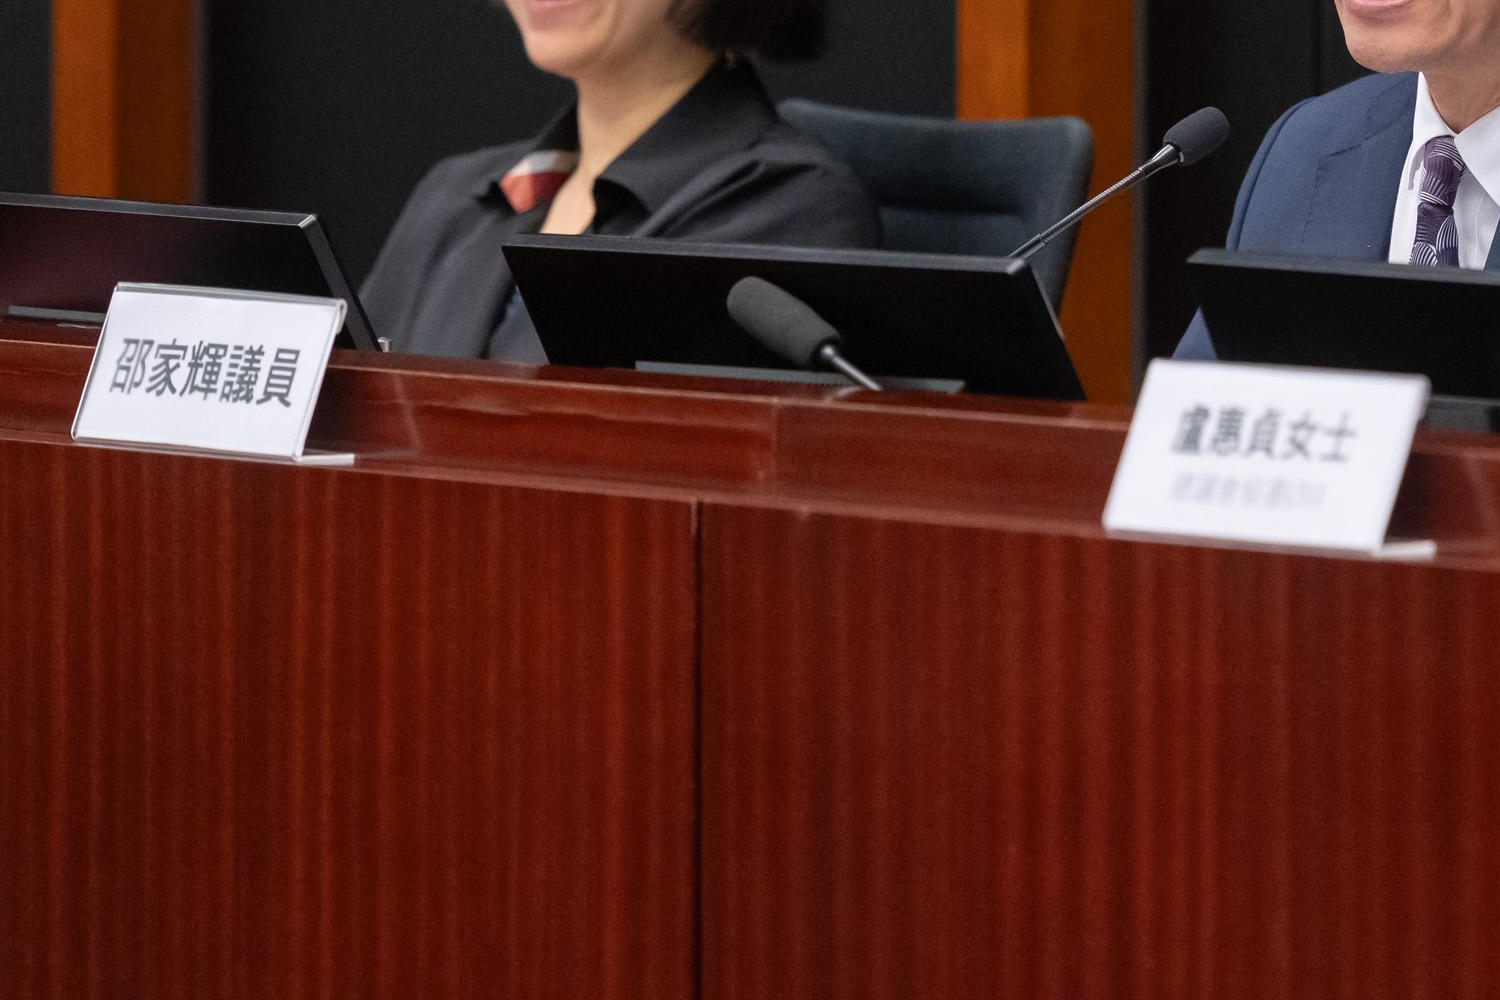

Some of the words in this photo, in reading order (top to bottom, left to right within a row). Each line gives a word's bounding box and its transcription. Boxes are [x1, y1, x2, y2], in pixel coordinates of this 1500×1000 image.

[109, 337, 301, 408] 邵家輝議員
